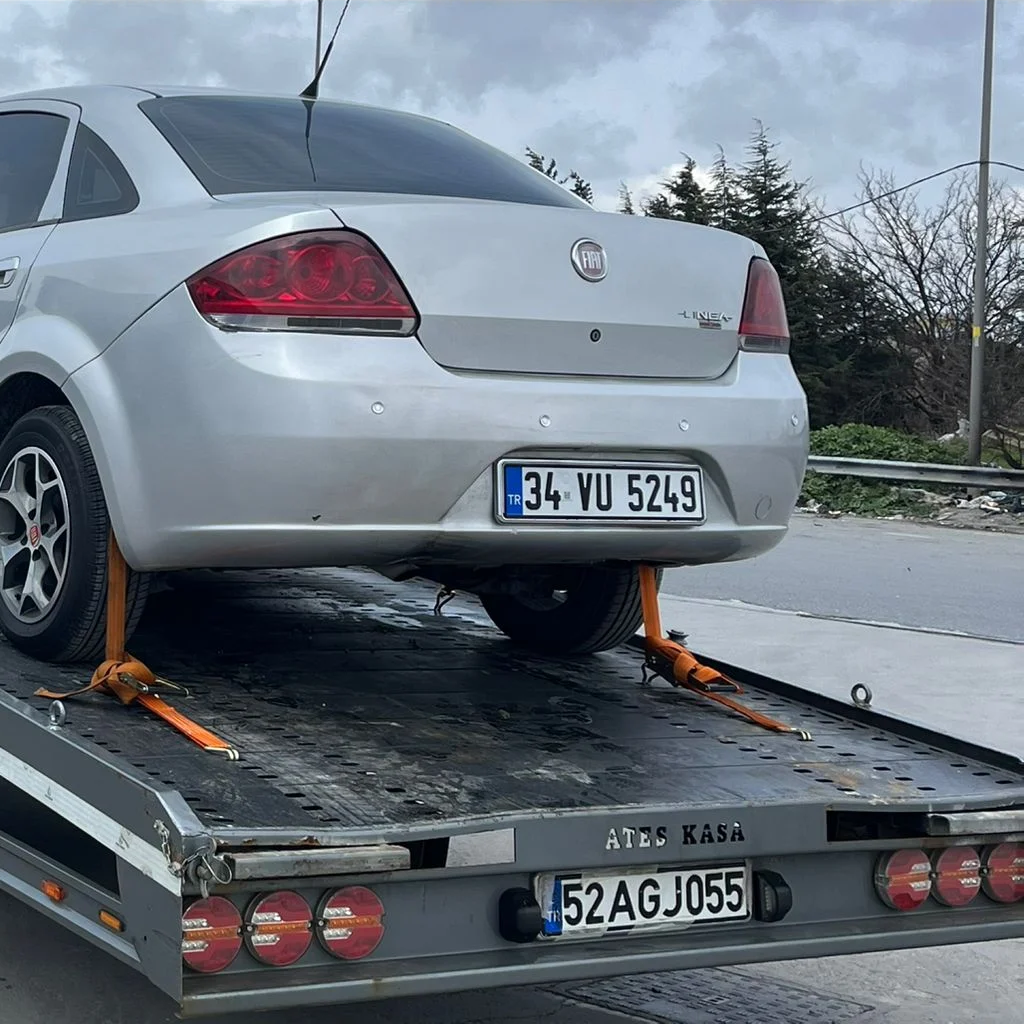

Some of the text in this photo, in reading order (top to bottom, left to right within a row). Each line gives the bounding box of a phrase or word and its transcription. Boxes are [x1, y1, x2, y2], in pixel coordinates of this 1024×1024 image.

[581, 250, 602, 269] FIAT
[680, 310, 731, 323] LINEA
[507, 472, 697, 513] TR 34 VU 5249
[606, 821, 745, 850] ATES KASA
